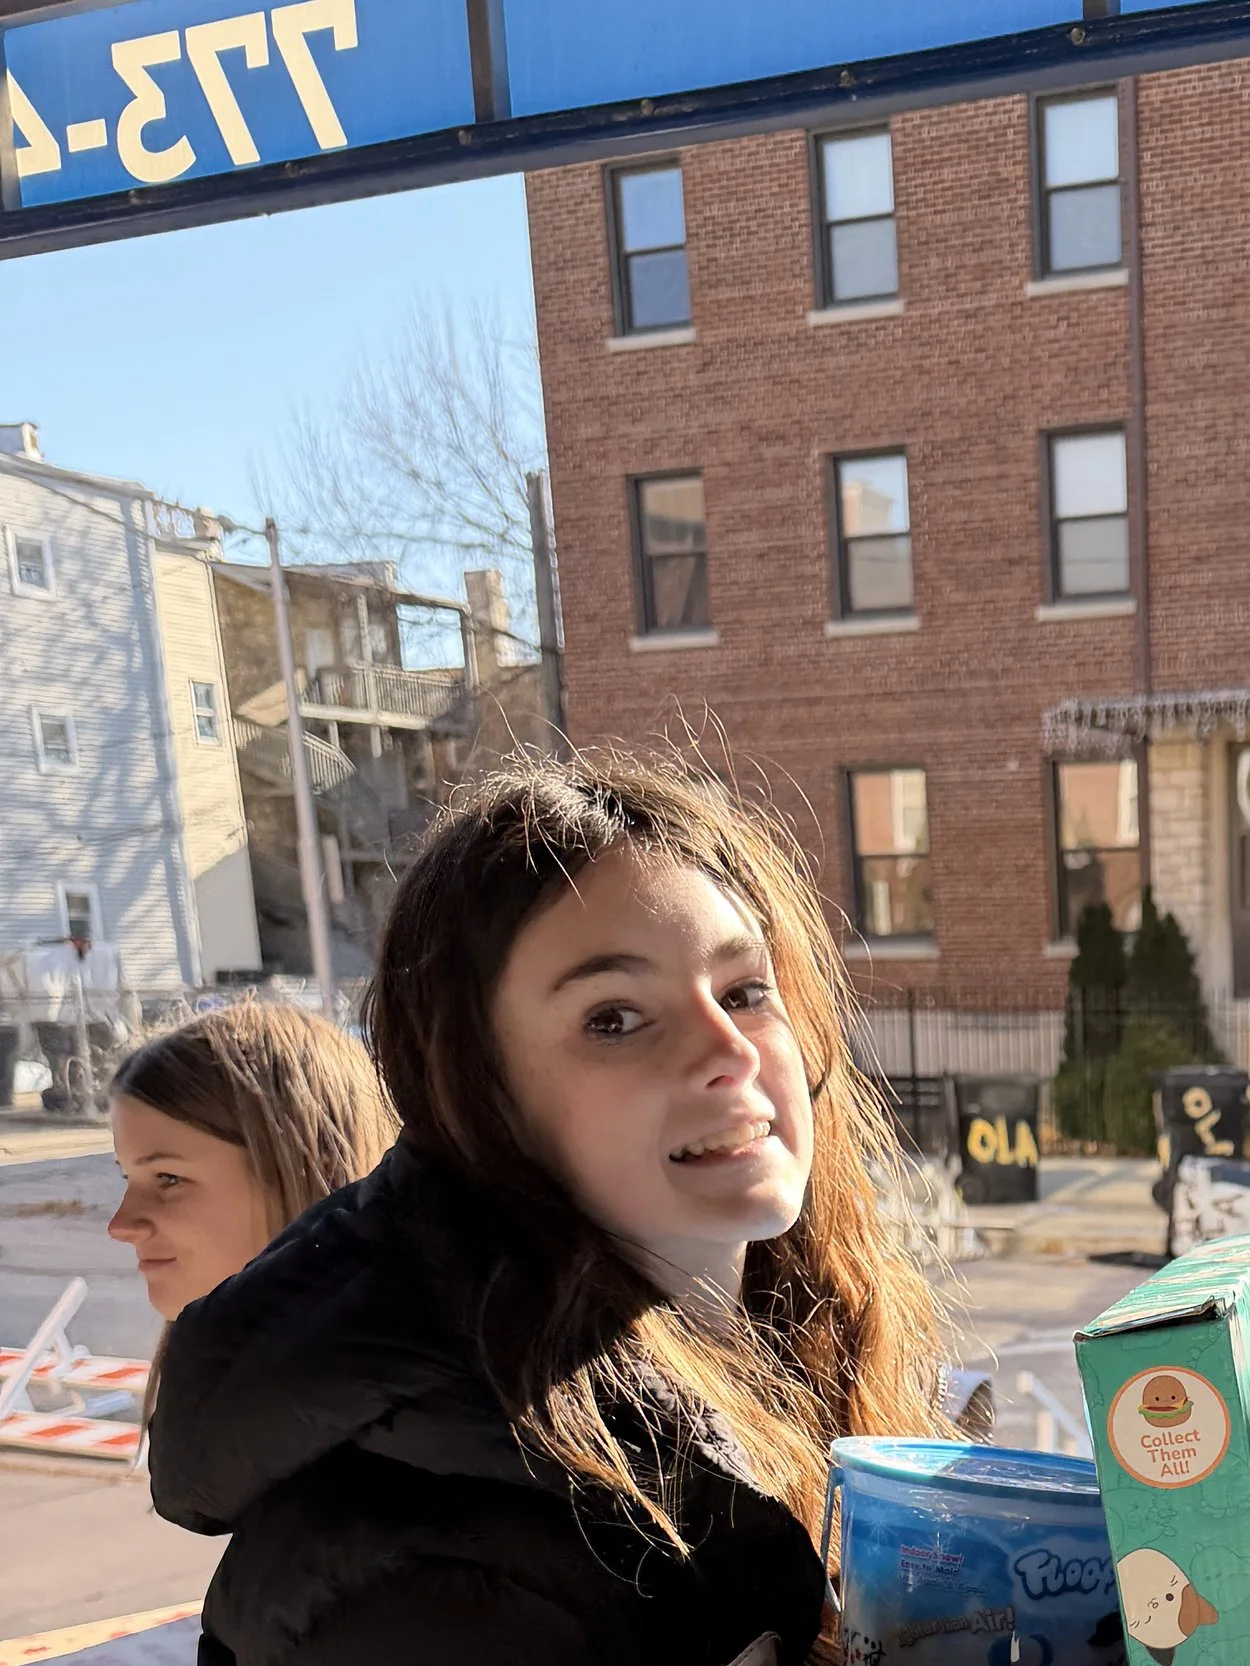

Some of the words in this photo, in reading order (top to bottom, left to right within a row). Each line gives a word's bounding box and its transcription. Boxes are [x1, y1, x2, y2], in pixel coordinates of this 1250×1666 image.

[967, 1116, 1040, 1167] OLA
[1140, 1429, 1201, 1448] Collect
[1147, 1448, 1197, 1463] Them
[1160, 1461, 1190, 1477] All!
[970, 1605, 1016, 1634] Air!
